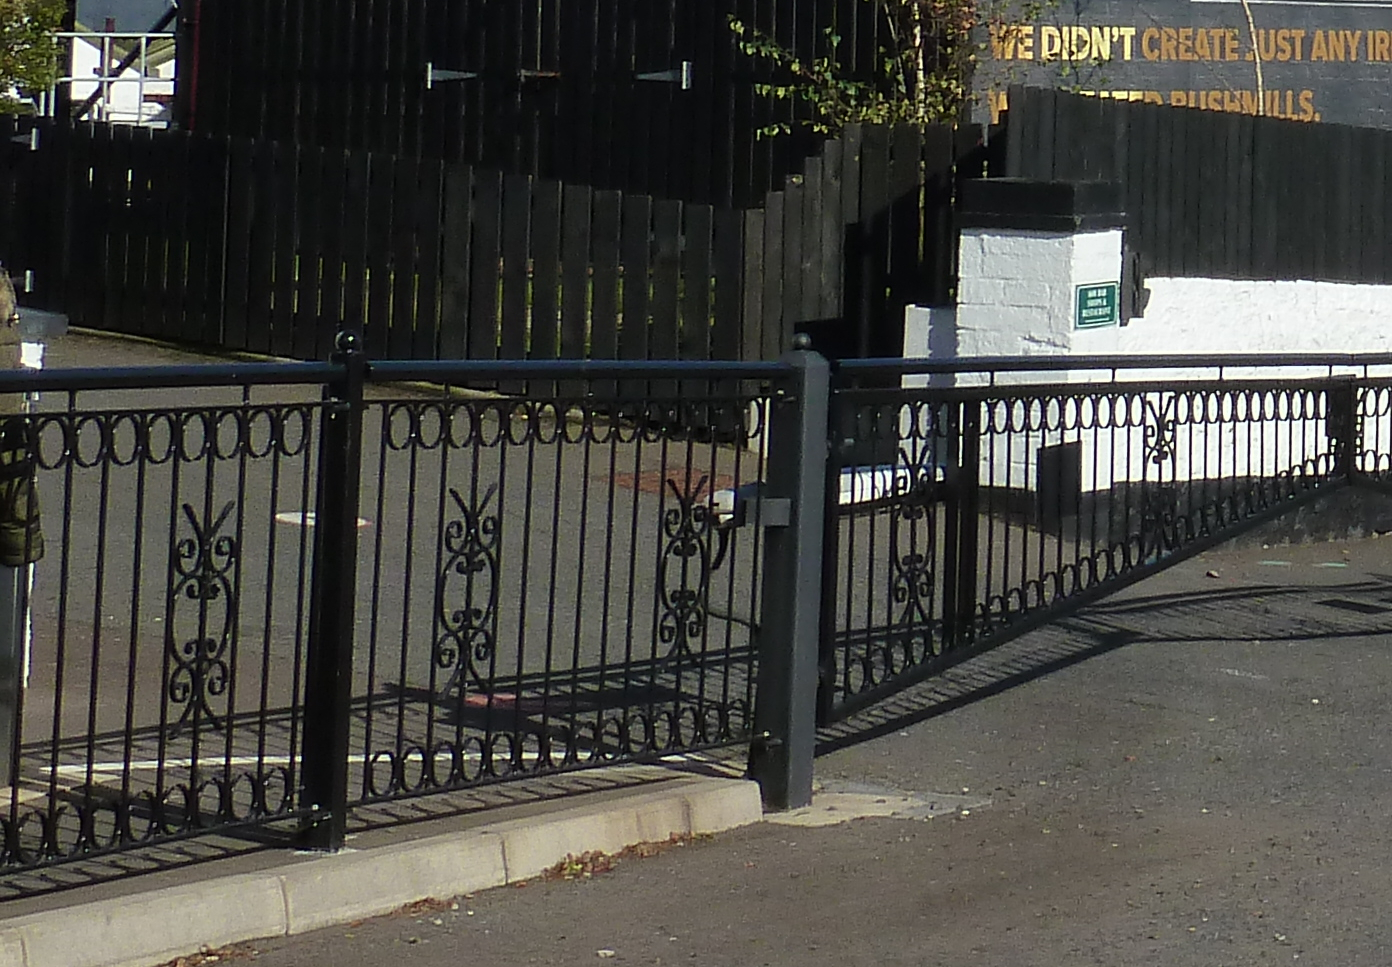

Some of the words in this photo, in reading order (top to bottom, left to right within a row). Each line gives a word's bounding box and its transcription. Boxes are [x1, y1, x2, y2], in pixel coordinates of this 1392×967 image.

[989, 24, 1034, 61] WE
[1040, 25, 1136, 61] DIDN'T
[1141, 27, 1239, 62] CREATE
[1311, 29, 1362, 63] ANY
